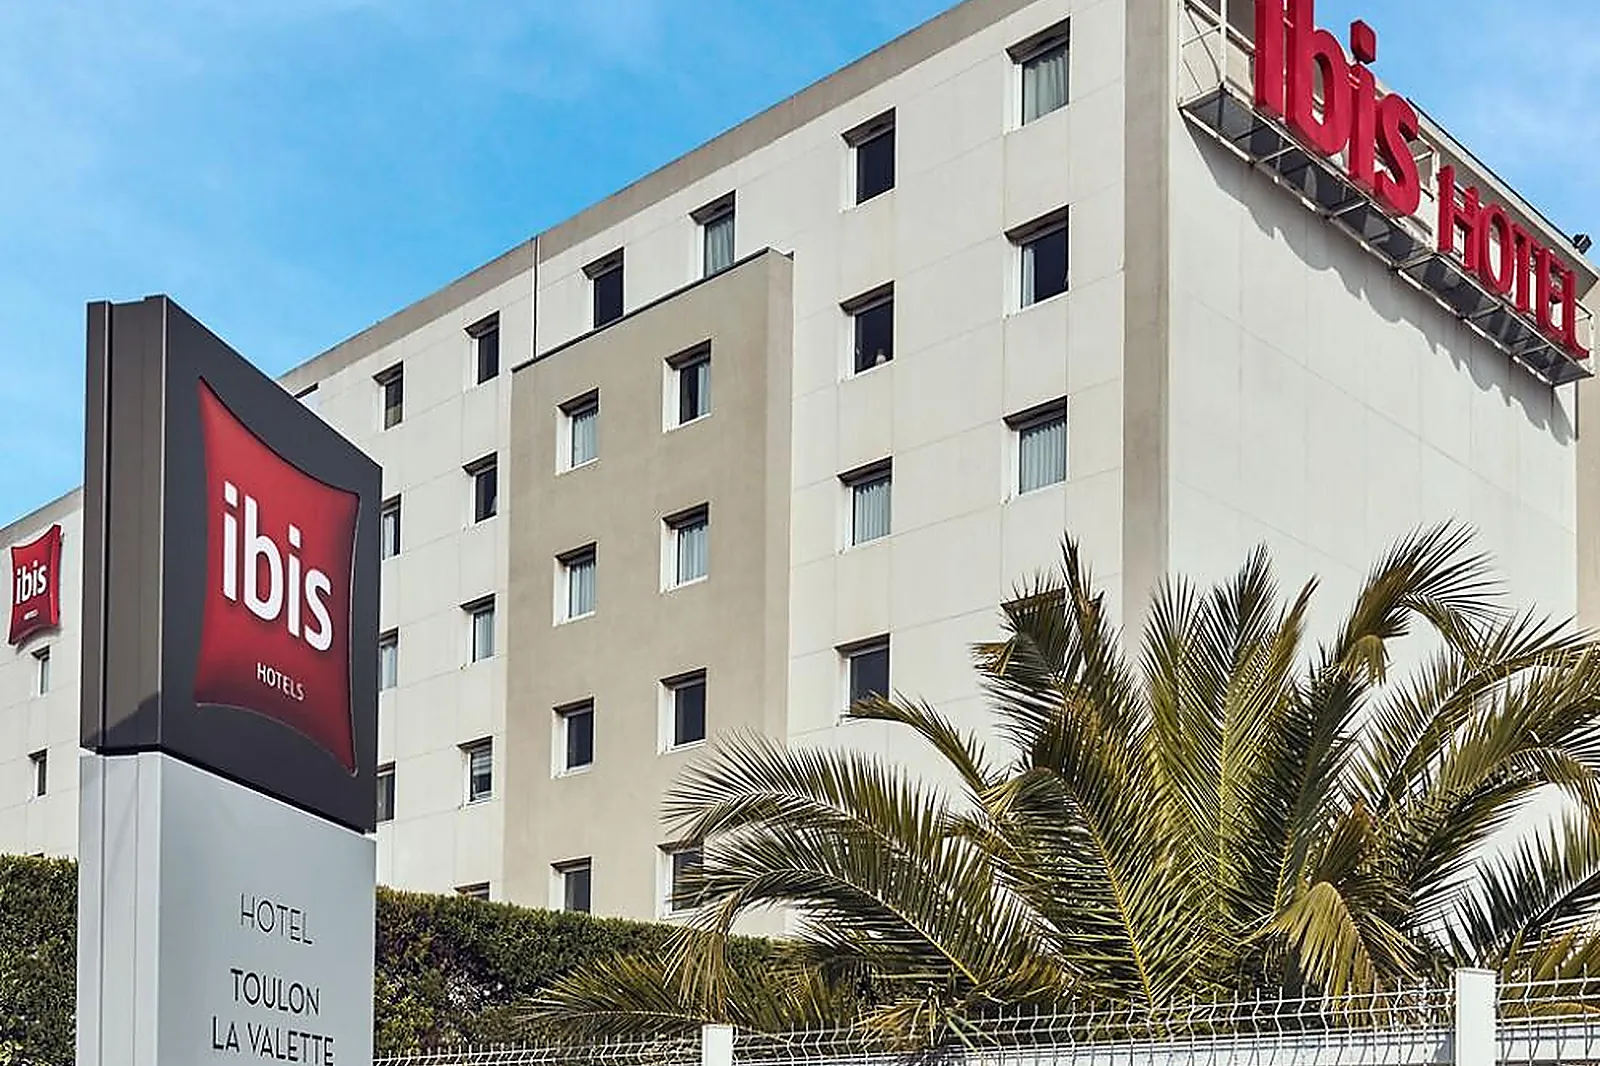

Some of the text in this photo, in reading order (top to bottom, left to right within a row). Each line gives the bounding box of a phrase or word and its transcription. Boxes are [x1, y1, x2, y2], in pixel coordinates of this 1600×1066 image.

[1254, 0, 1590, 359] ibis HOTEL
[15, 560, 47, 604] ibis
[223, 481, 332, 651] ibis
[257, 662, 304, 701] HOTELS
[240, 893, 312, 945] HOTEL
[230, 968, 320, 1016] TOULON
[212, 1016, 333, 1066] LA VALETTE
